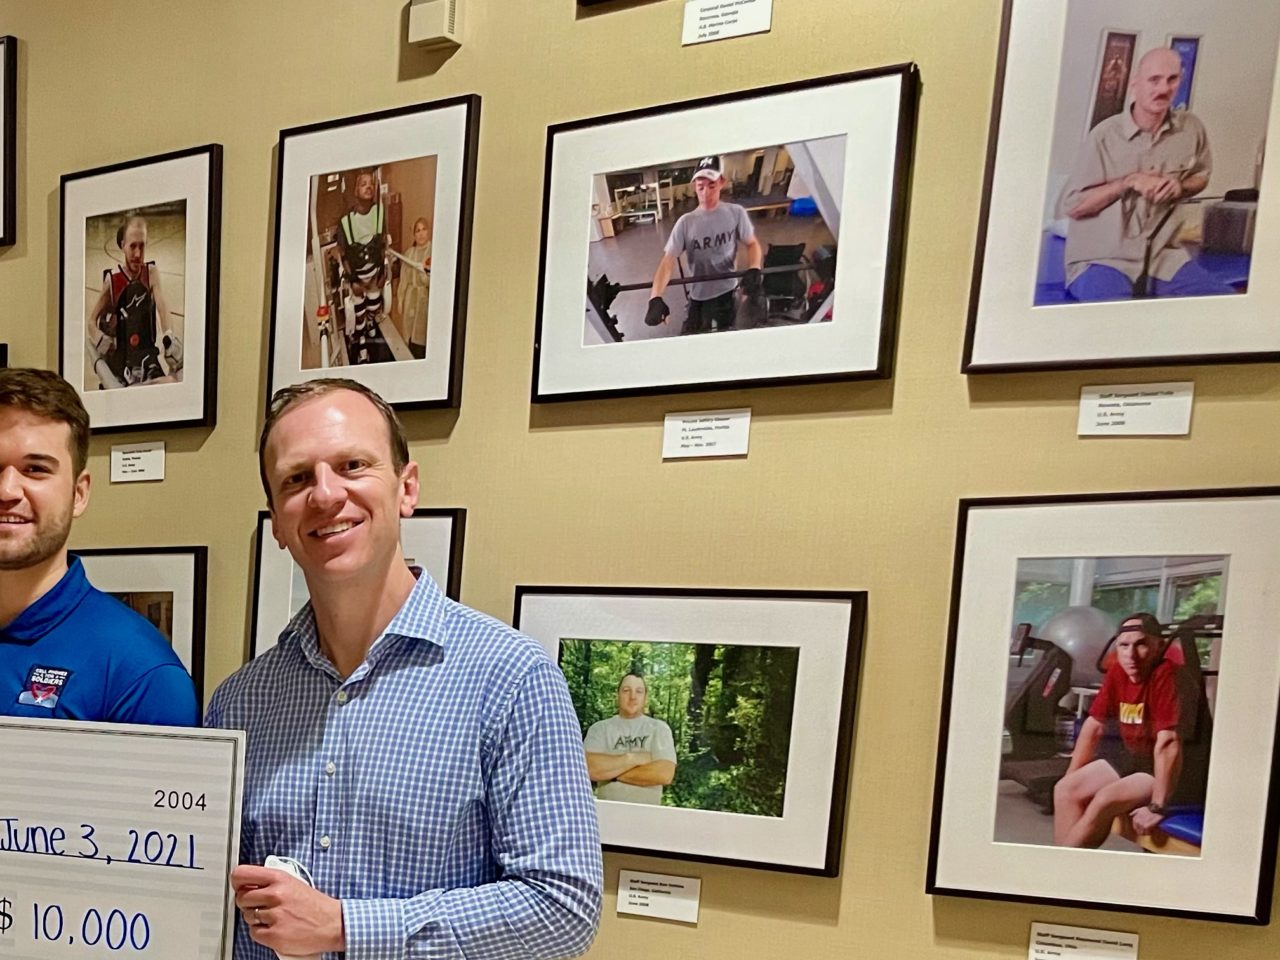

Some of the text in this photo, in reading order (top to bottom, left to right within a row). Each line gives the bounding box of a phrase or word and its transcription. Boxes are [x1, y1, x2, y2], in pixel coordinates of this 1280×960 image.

[692, 229, 735, 250] ARMY
[154, 790, 207, 811] 2004
[79, 824, 113, 865] 3,
[127, 829, 196, 868] 2021
[34, 903, 151, 951] 10,000
